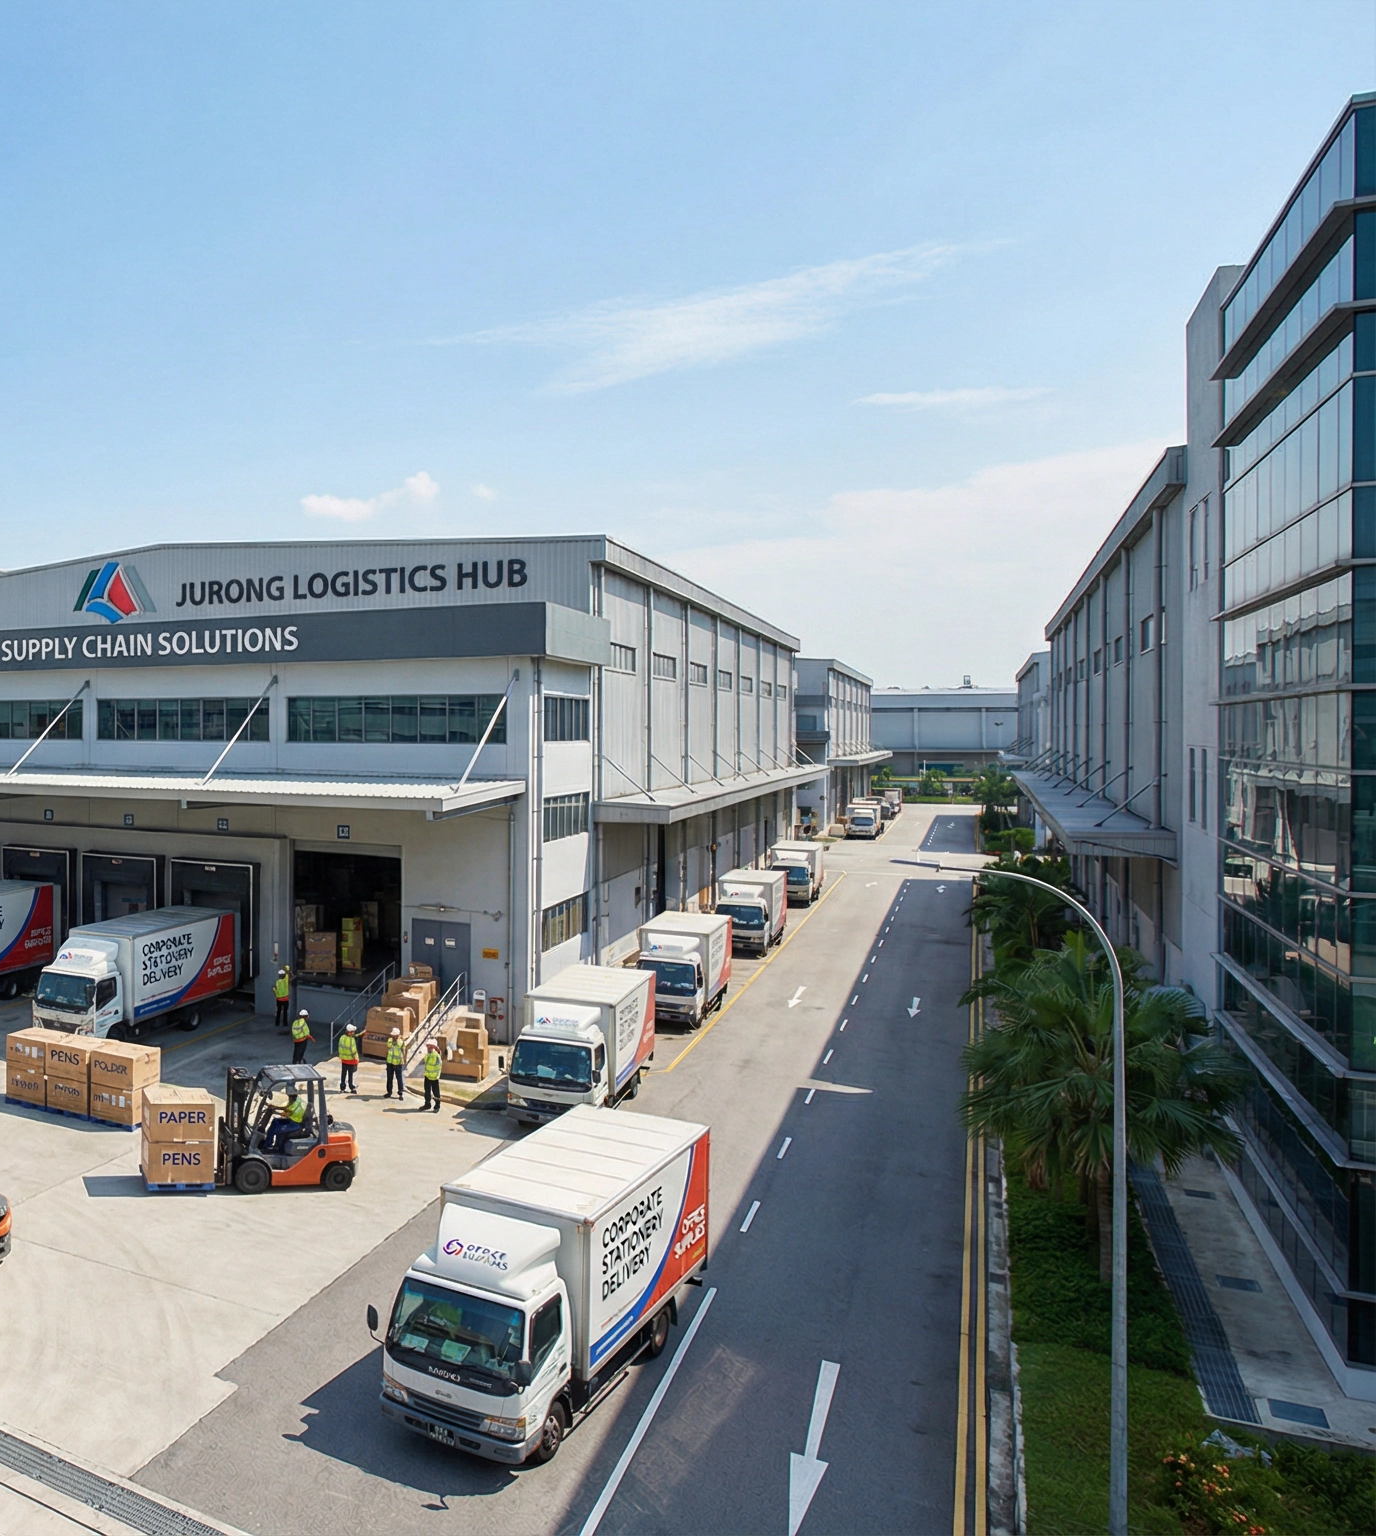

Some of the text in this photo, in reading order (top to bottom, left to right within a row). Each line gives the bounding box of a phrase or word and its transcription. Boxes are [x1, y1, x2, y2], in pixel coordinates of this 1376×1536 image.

[175, 558, 529, 607] JURONG LOGISTICS HUB
[1, 636, 78, 662] SUPPLY
[82, 632, 153, 659] CHAIN
[158, 626, 299, 655] SOLUTIONS
[50, 1049, 80, 1066] PENS
[159, 1111, 207, 1124] PAPER
[162, 1153, 201, 1166] PENS
